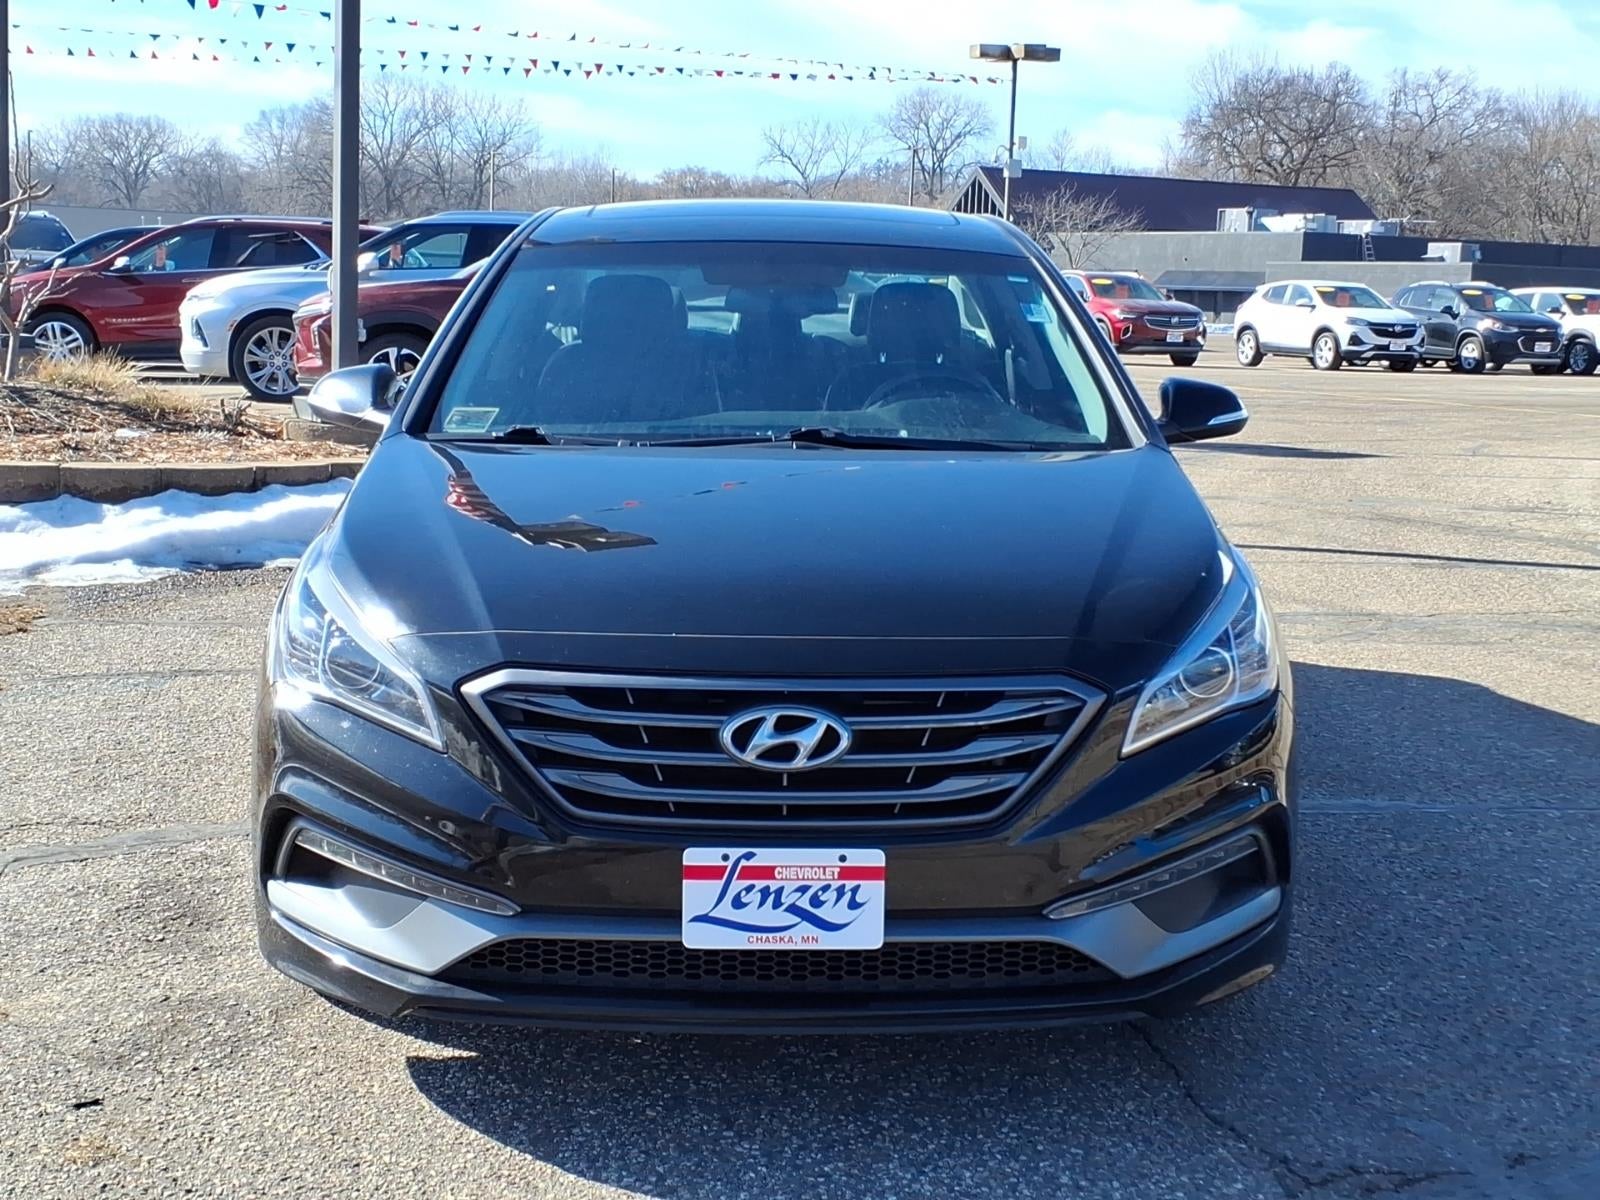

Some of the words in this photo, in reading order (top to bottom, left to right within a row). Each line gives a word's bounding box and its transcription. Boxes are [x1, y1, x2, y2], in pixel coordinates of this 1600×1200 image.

[774, 866, 841, 880] CHEVROLET
[688, 851, 870, 933] Lenzen
[747, 935, 798, 946] CHASKA,
[801, 935, 819, 945] MN
